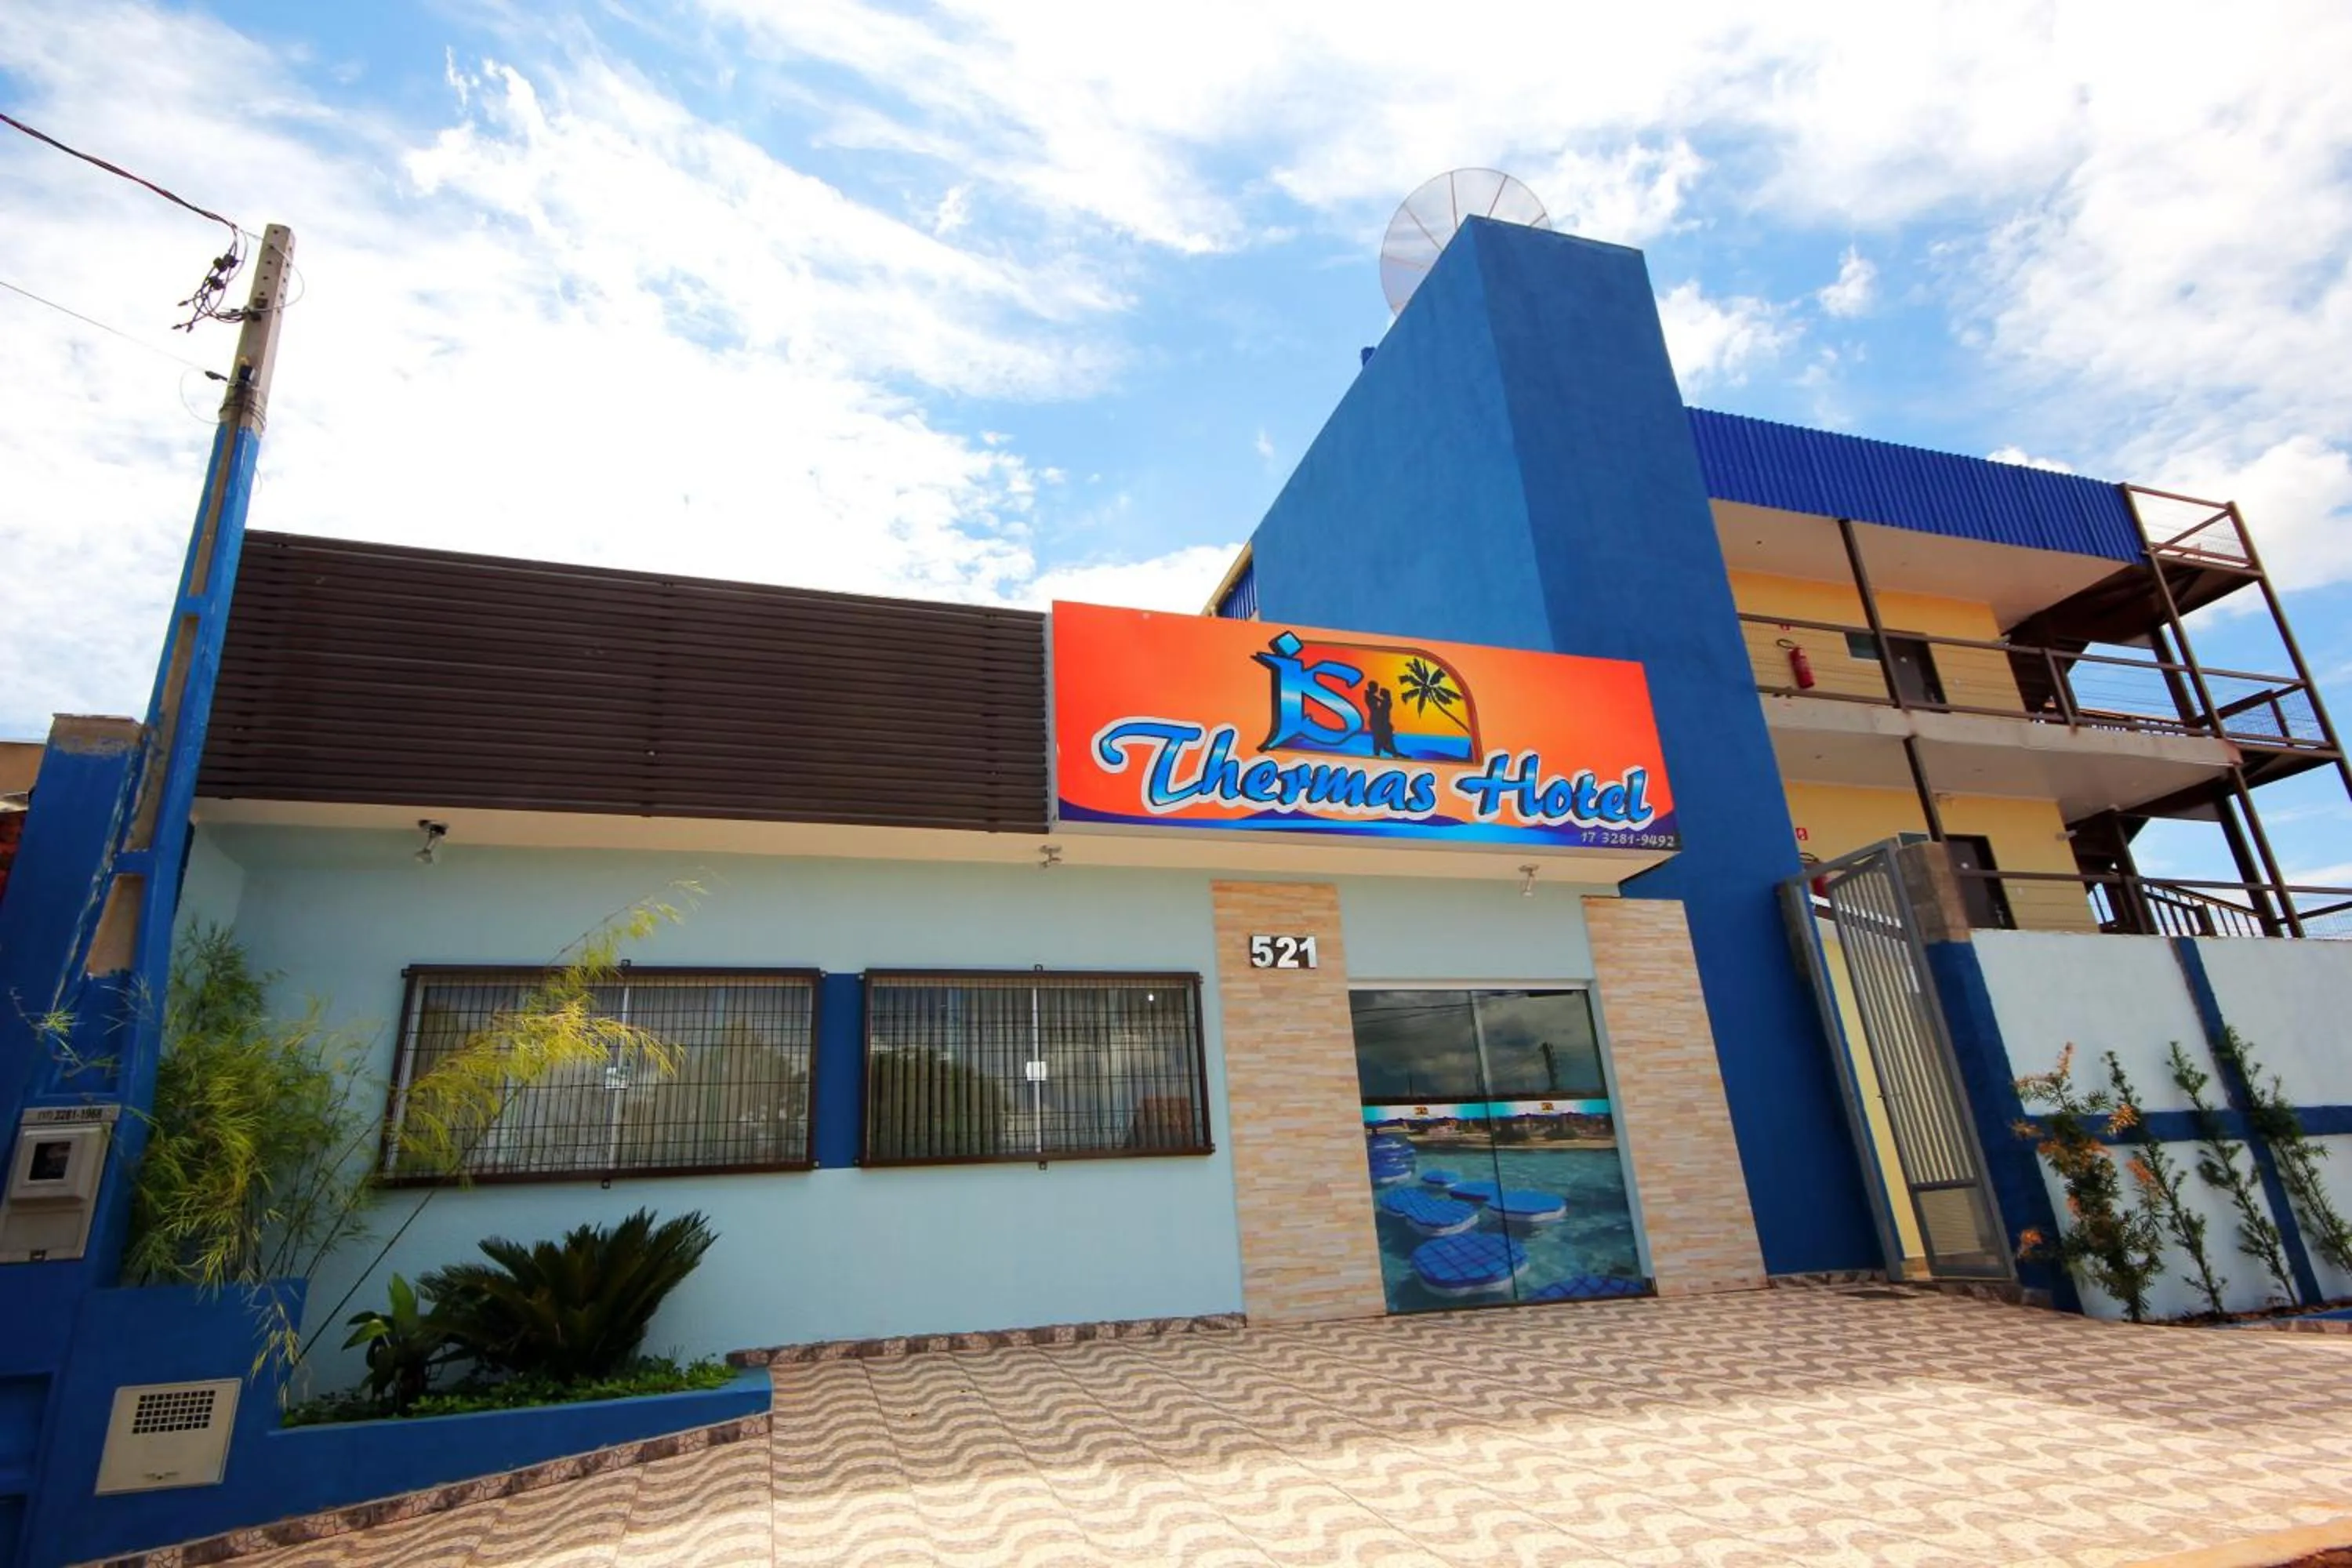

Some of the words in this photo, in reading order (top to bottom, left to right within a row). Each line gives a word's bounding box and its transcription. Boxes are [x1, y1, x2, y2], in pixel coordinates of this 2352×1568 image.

[1098, 721, 1436, 813] Thermas
[1454, 753, 1654, 823] Hotel
[1580, 831, 1596, 844] 17
[1601, 831, 1675, 848] 3281-9492
[1250, 935, 1318, 968] 521
